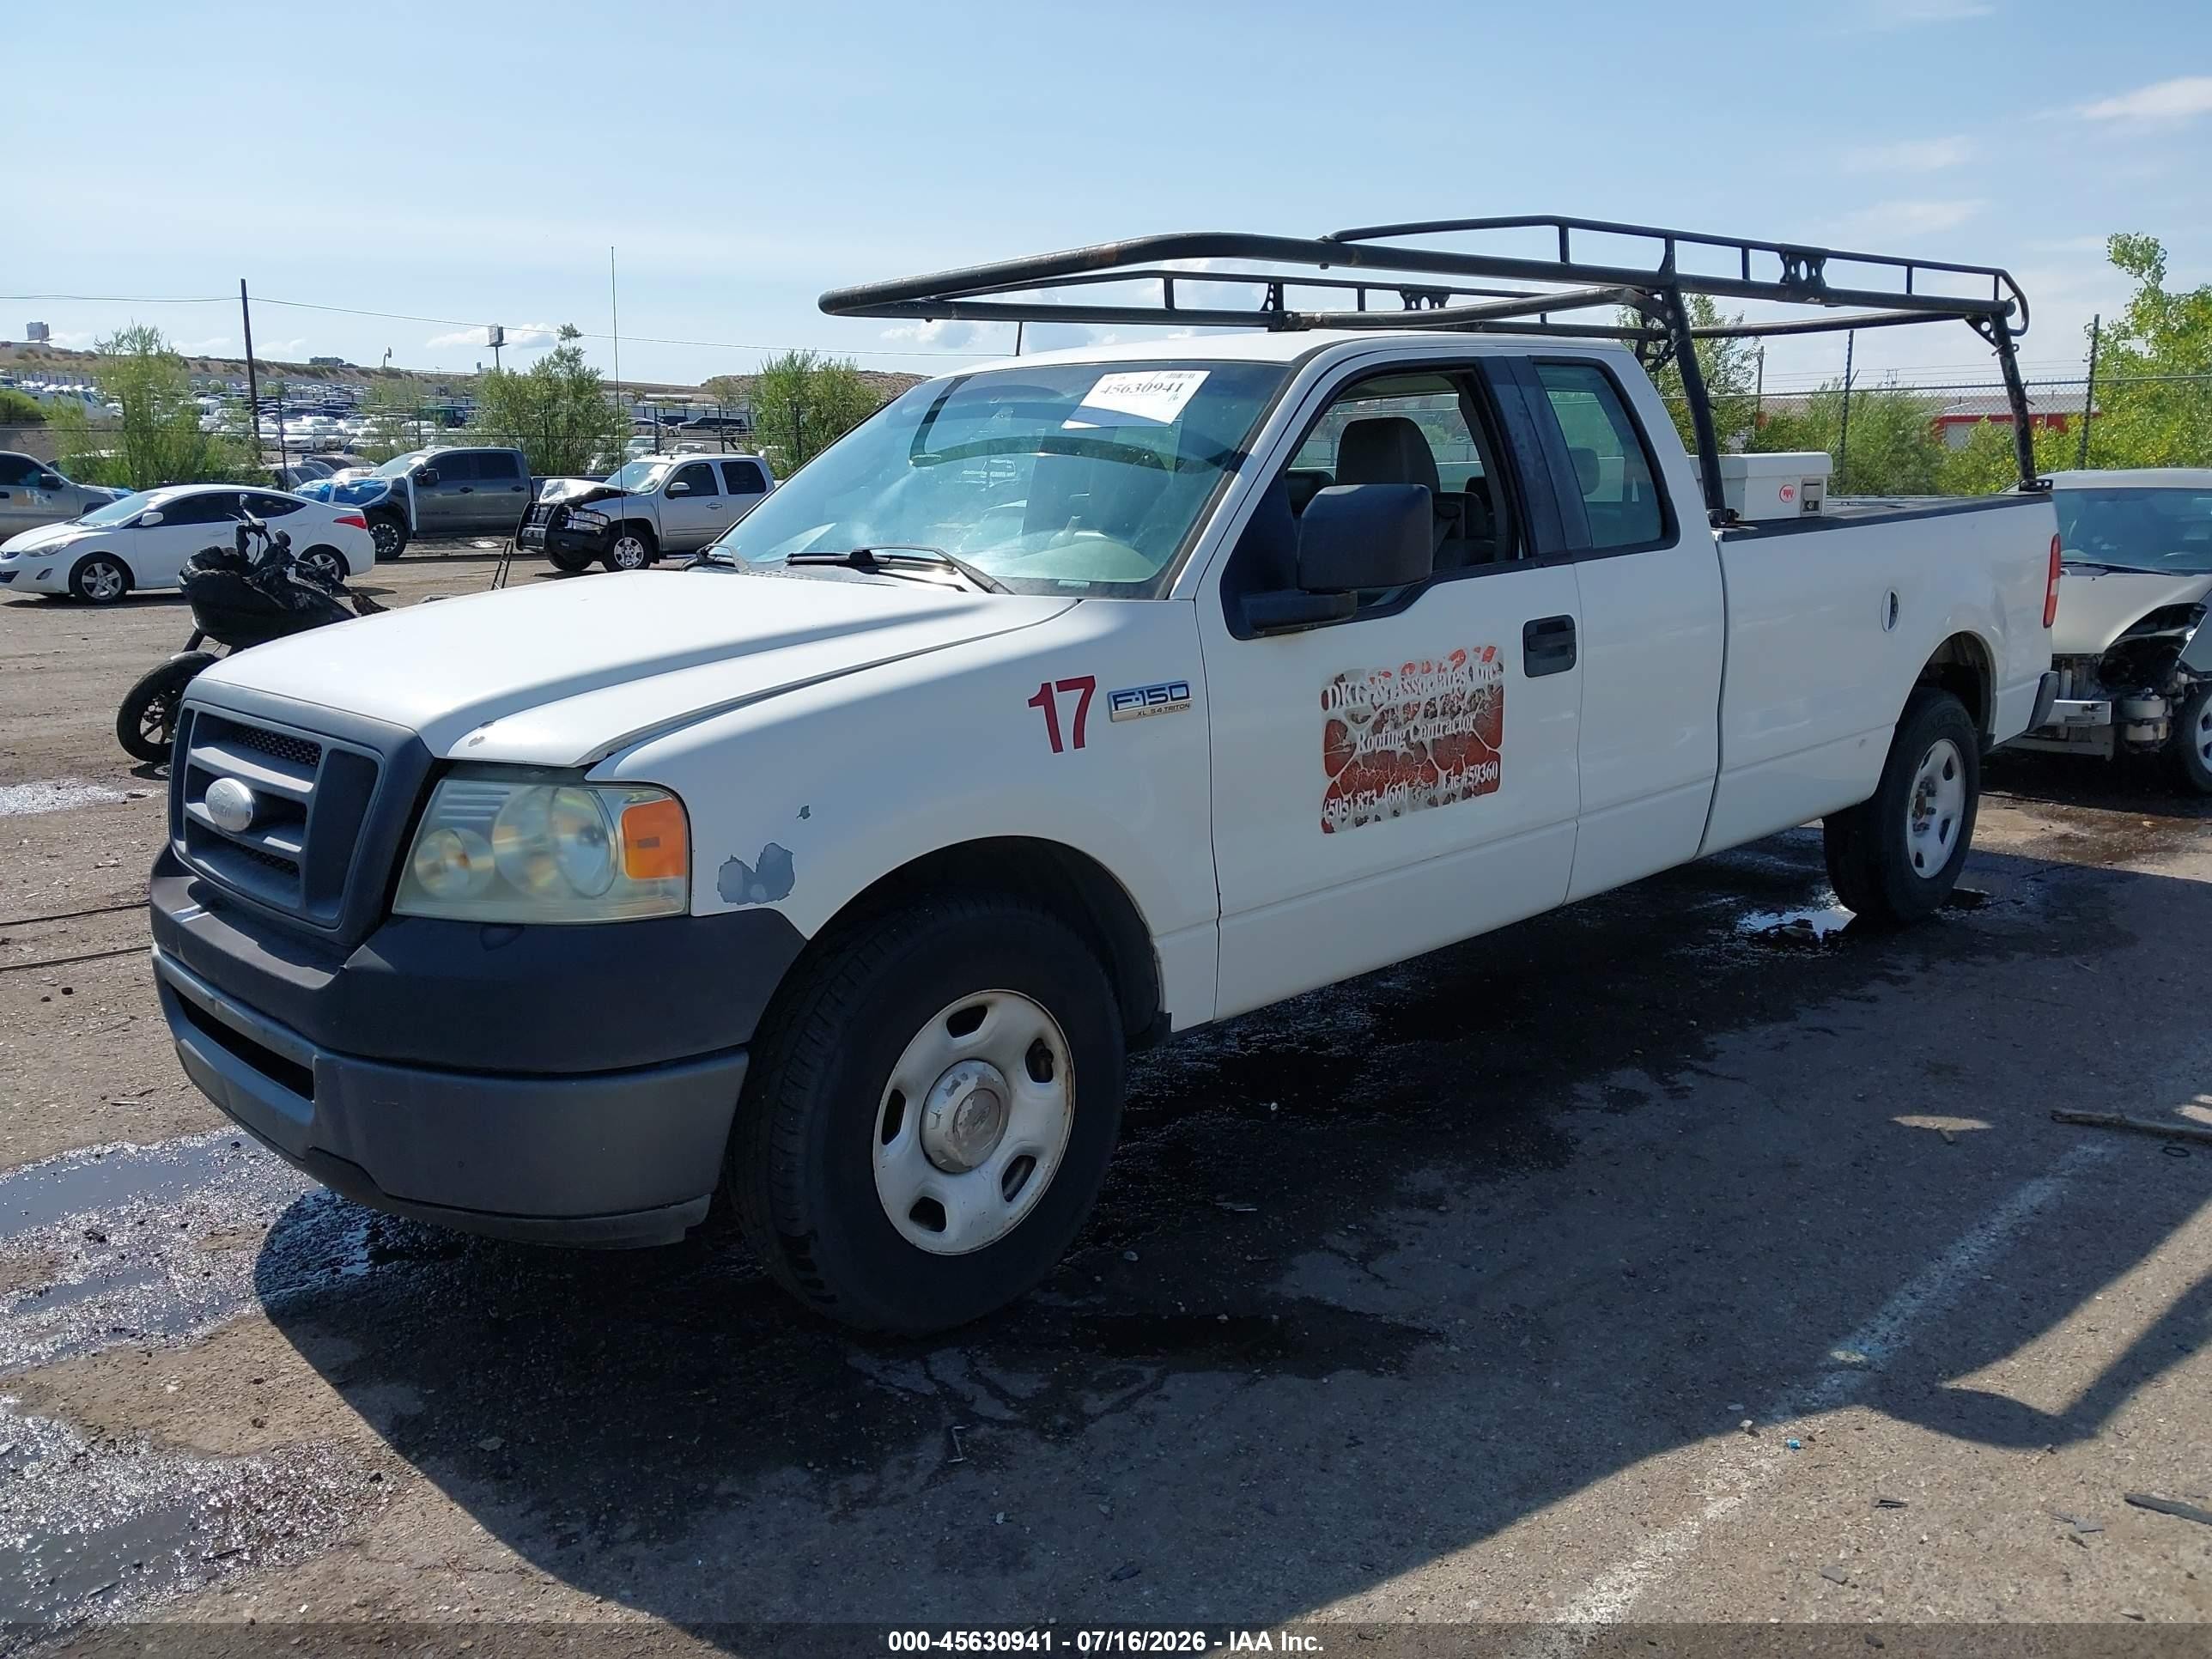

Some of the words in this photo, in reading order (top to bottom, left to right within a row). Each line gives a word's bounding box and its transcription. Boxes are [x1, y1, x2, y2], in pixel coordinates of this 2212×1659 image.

[1100, 382, 1184, 394] 45630941
[1028, 674, 1096, 753] 17
[1164, 702, 1190, 712] TRITON
[1358, 726, 1407, 753] Roofing
[1409, 714, 1475, 741] Contractor
[1323, 795, 1354, 824] (505)
